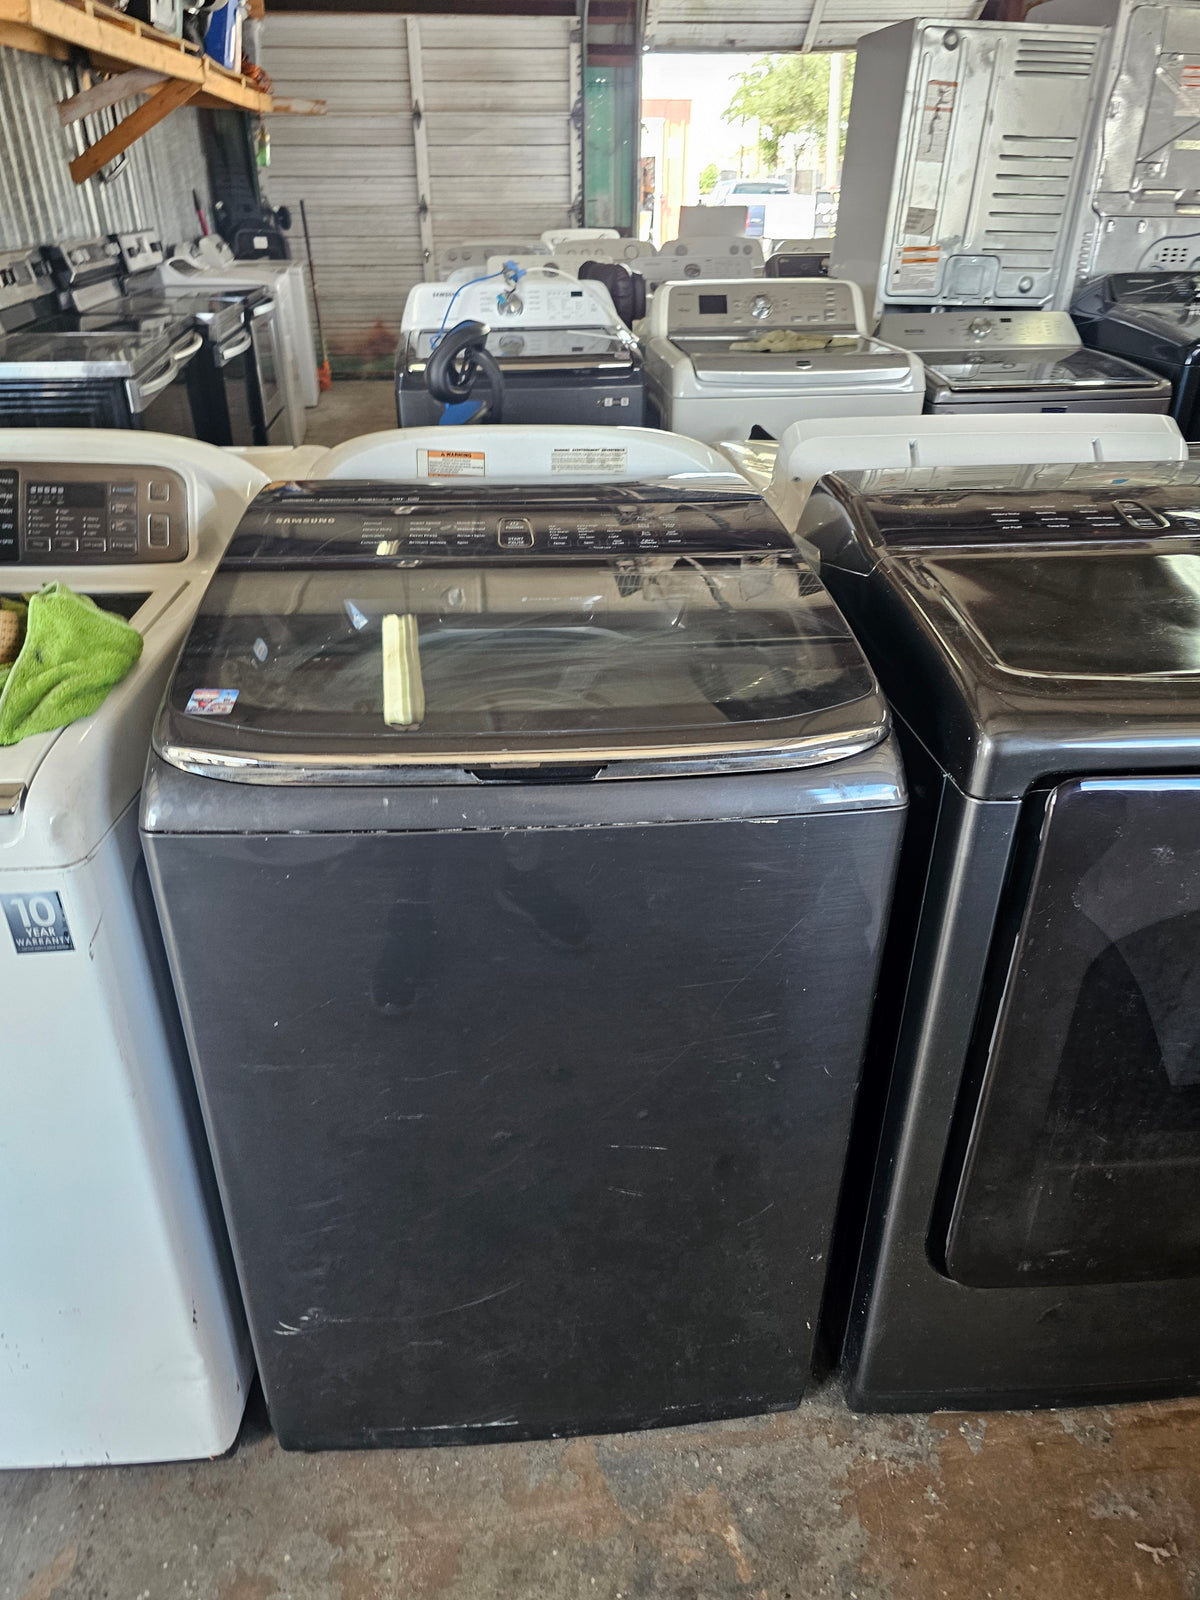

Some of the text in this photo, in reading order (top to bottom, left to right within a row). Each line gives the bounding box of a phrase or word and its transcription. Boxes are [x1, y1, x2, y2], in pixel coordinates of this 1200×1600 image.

[10, 897, 56, 928] 10
[25, 926, 56, 938] YEAR
[15, 936, 72, 947] WARRANTY
